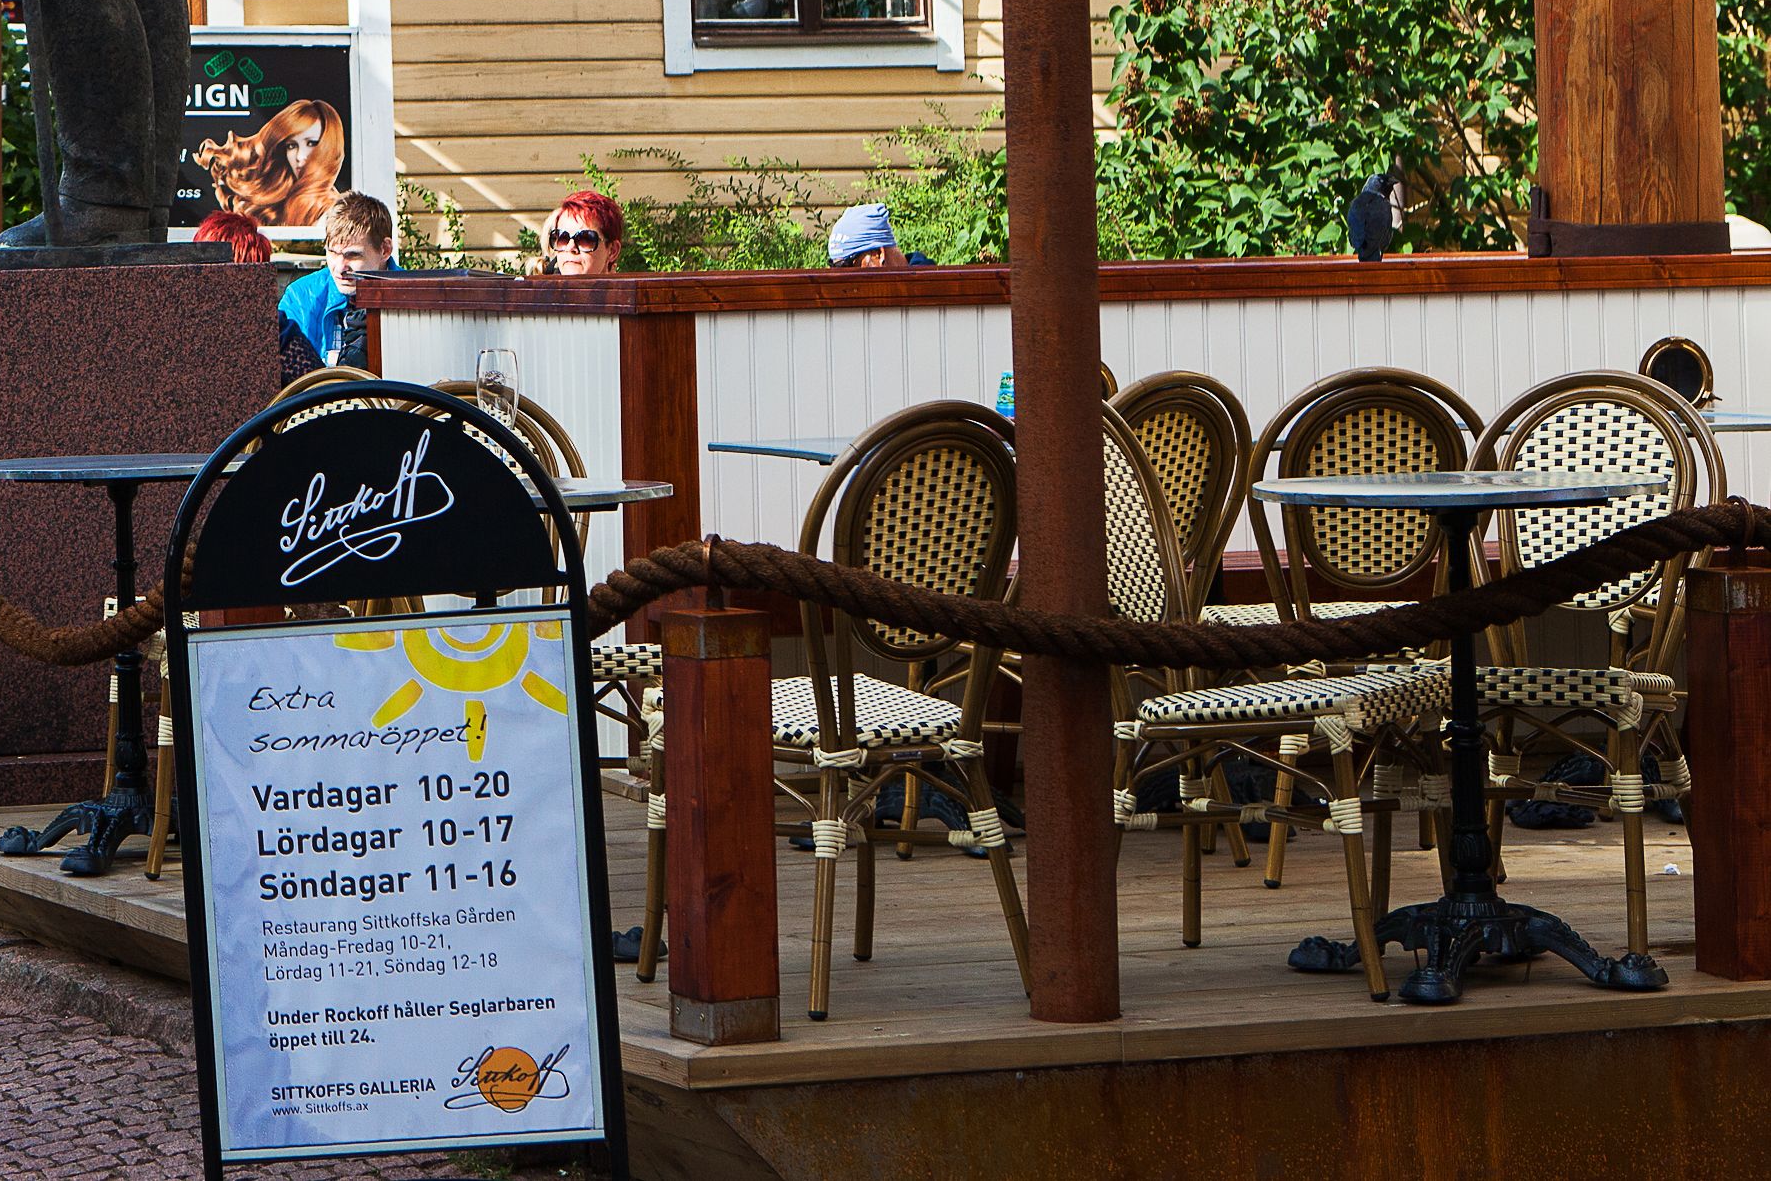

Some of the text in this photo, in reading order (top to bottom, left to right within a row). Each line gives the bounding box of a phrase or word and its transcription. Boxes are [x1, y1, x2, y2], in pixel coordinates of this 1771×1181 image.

[280, 429, 455, 587] Sittkoff
[248, 685, 336, 712] Extra
[248, 714, 488, 755] sommaröppet!
[251, 770, 511, 814] Vardagar 10-20
[257, 815, 514, 858] Lördagar 10-17
[259, 859, 518, 902] Söndagar 11-16
[262, 907, 516, 937] Restaurang Sittkoffska Gården
[264, 933, 452, 959] Måndag-Fredag 10-21,
[265, 952, 499, 982] Lördag 11-21, Söndag 12-18
[267, 995, 557, 1026] Under Rockoff håller Seglarbaren
[269, 1028, 376, 1052] öppet till 24.
[271, 1079, 436, 1101] SITTKOFFS GALLERIA
[444, 1044, 571, 1114] Sittkoff
